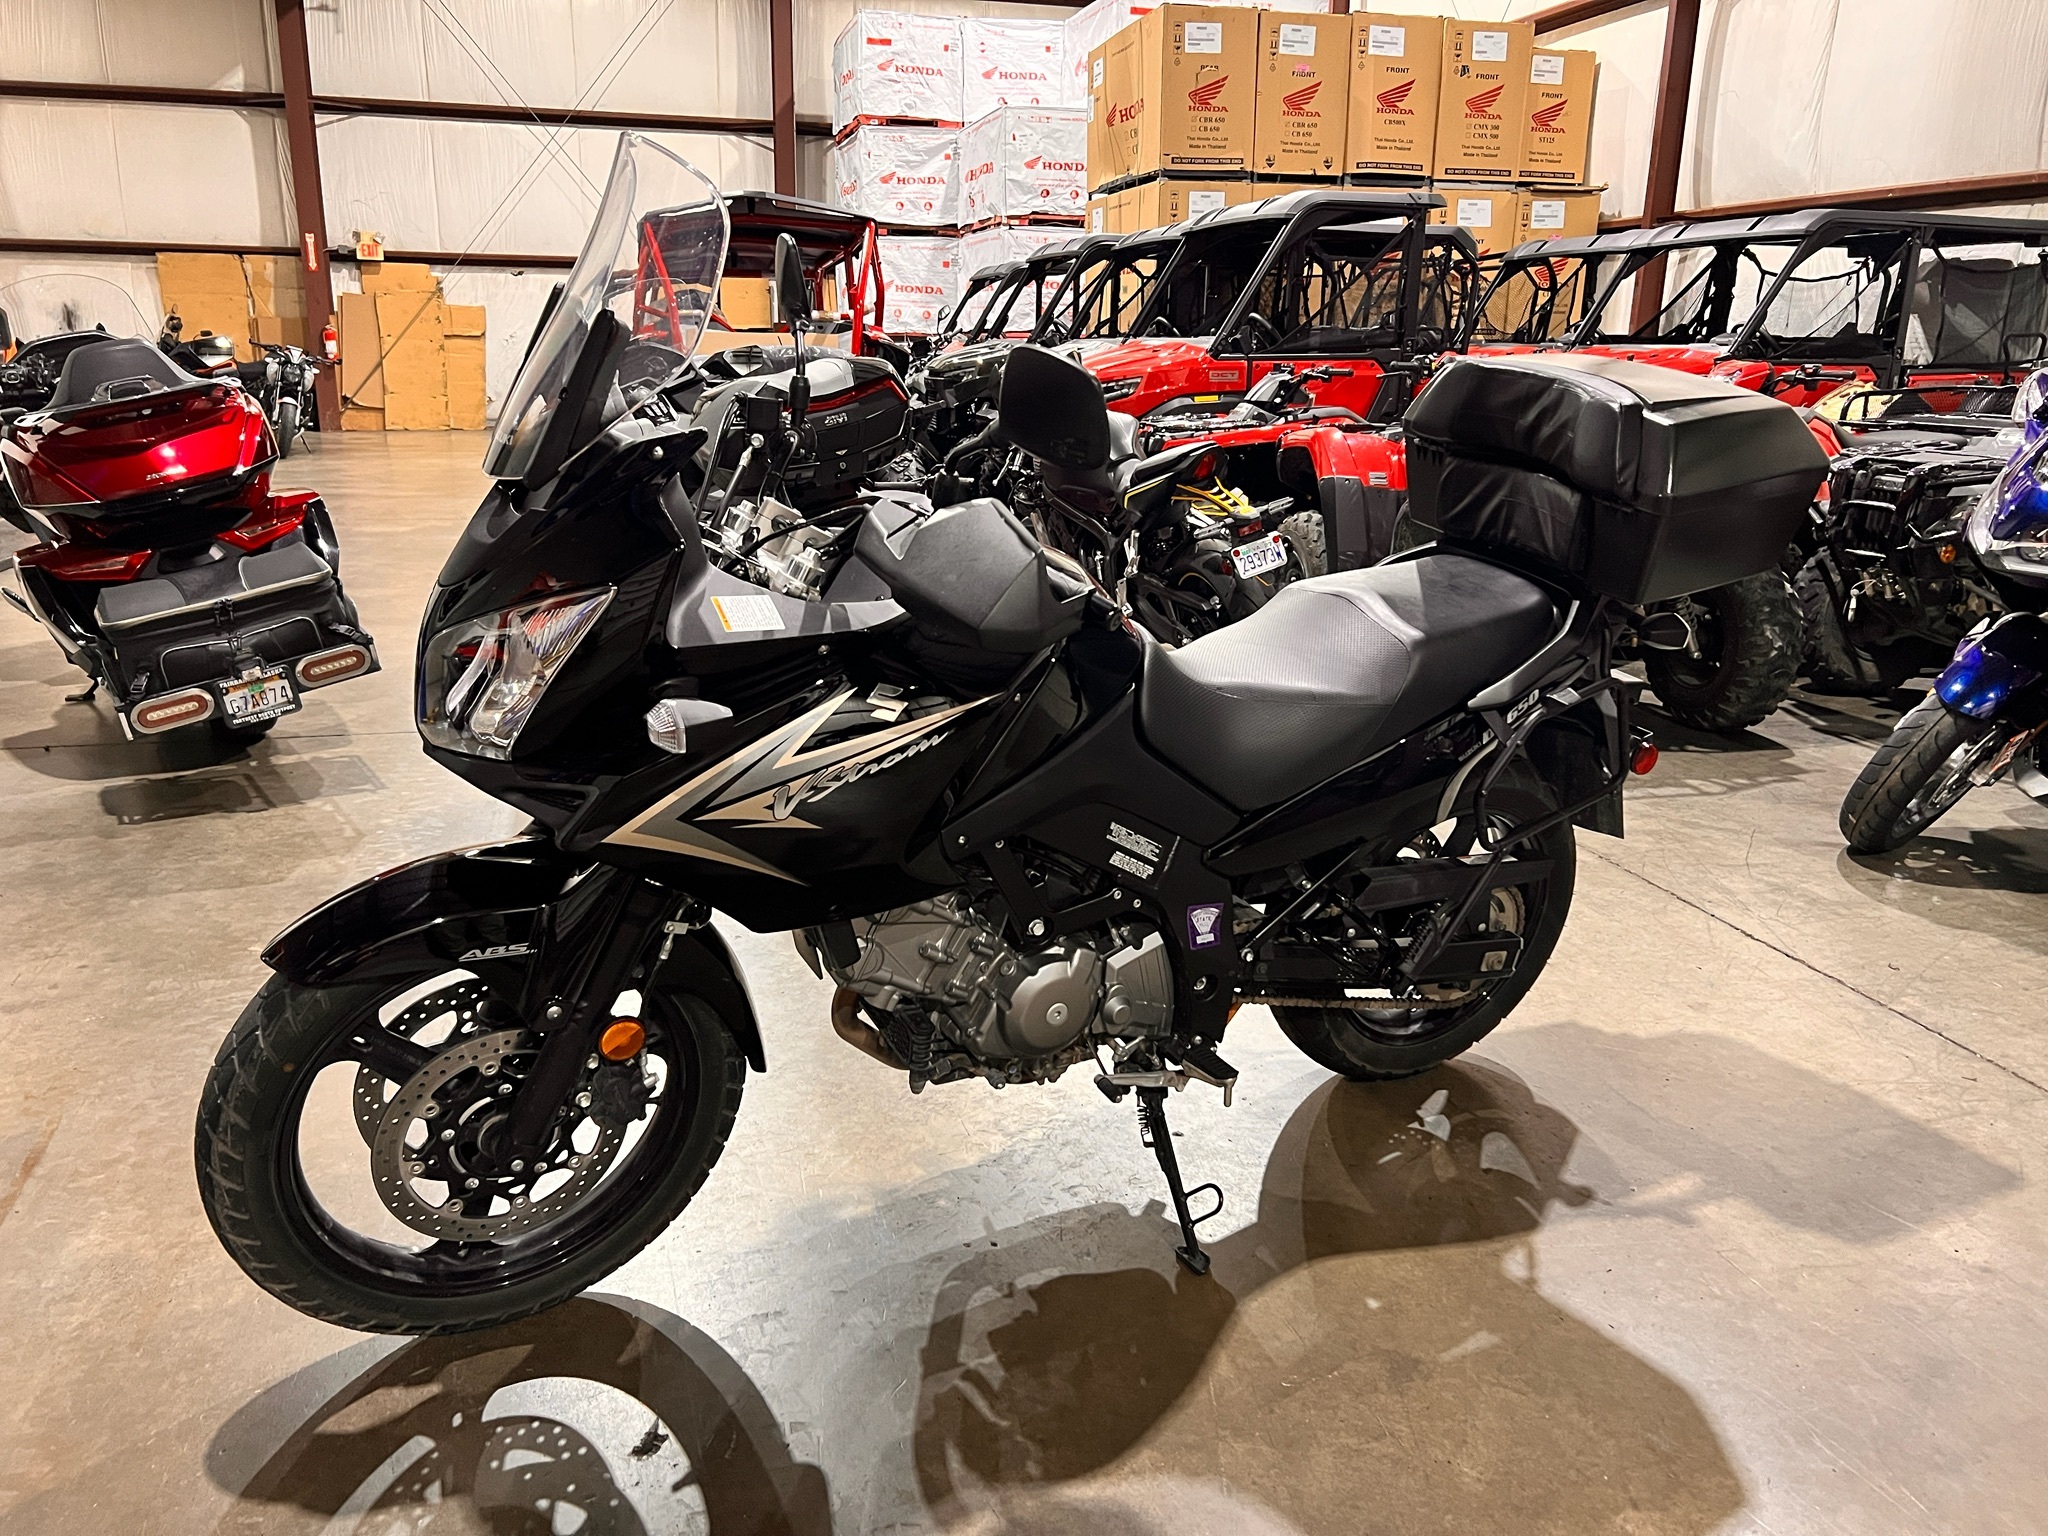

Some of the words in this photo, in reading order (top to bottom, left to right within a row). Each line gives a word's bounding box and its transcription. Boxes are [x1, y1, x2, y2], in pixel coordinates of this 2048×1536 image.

[894, 64, 944, 77] HONDA
[999, 71, 1047, 81] HONDA
[1376, 107, 1415, 116] HONDA
[969, 162, 994, 181] HDA
[1042, 161, 1088, 172] HOND
[896, 176, 946, 185] HONDA
[361, 243, 379, 257] EXIT
[895, 284, 944, 295] HONDA
[1240, 545, 1284, 572] 29373W
[262, 668, 284, 678] LASKA
[230, 685, 289, 714] G7A874
[1506, 688, 1539, 724] 650
[458, 942, 530, 961] ABS
